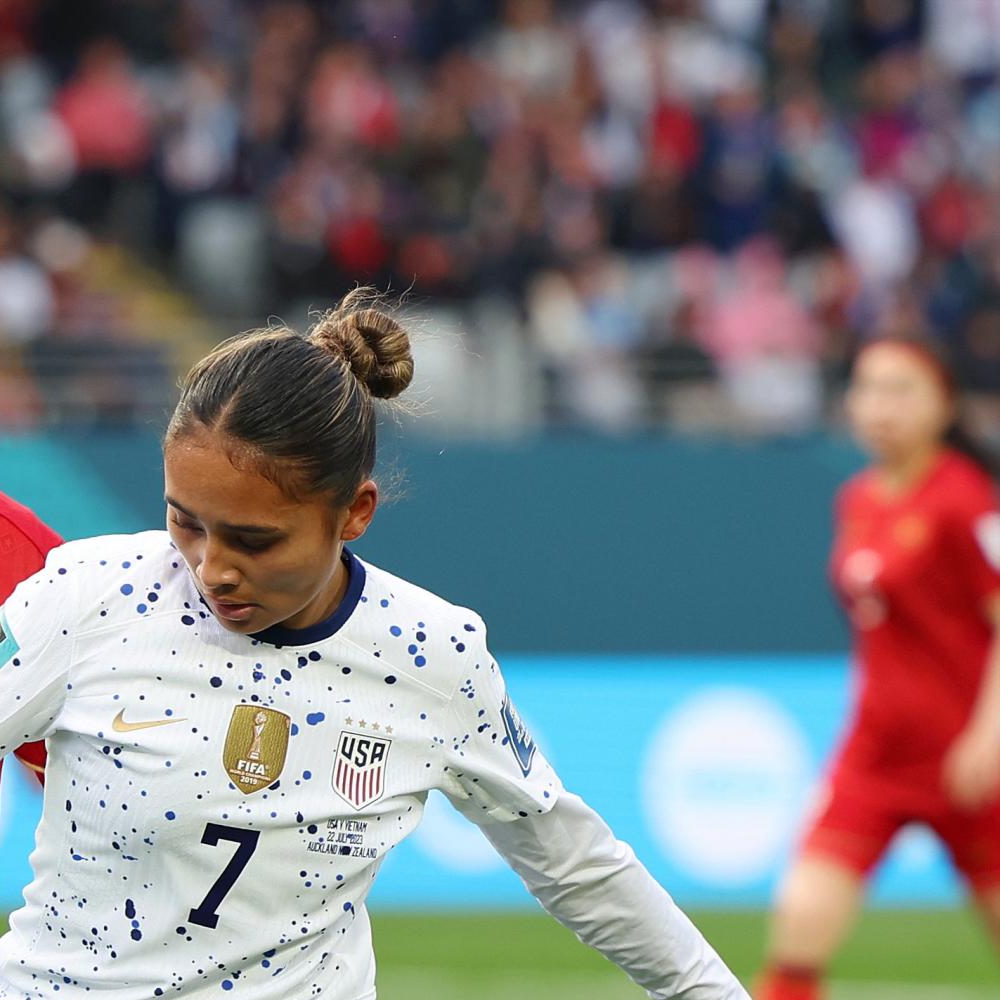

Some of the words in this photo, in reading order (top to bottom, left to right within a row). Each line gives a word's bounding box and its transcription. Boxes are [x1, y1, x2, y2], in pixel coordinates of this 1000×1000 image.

[340, 736, 387, 768] USA
[237, 759, 265, 775] FIFA
[239, 775, 258, 785] 2019
[327, 819, 338, 829] USA
[327, 831, 335, 841] 22
[336, 833, 347, 843] JULY
[306, 841, 338, 855] AUCKLAND
[352, 847, 377, 858] ZEALAND
[187, 821, 262, 930] 7
